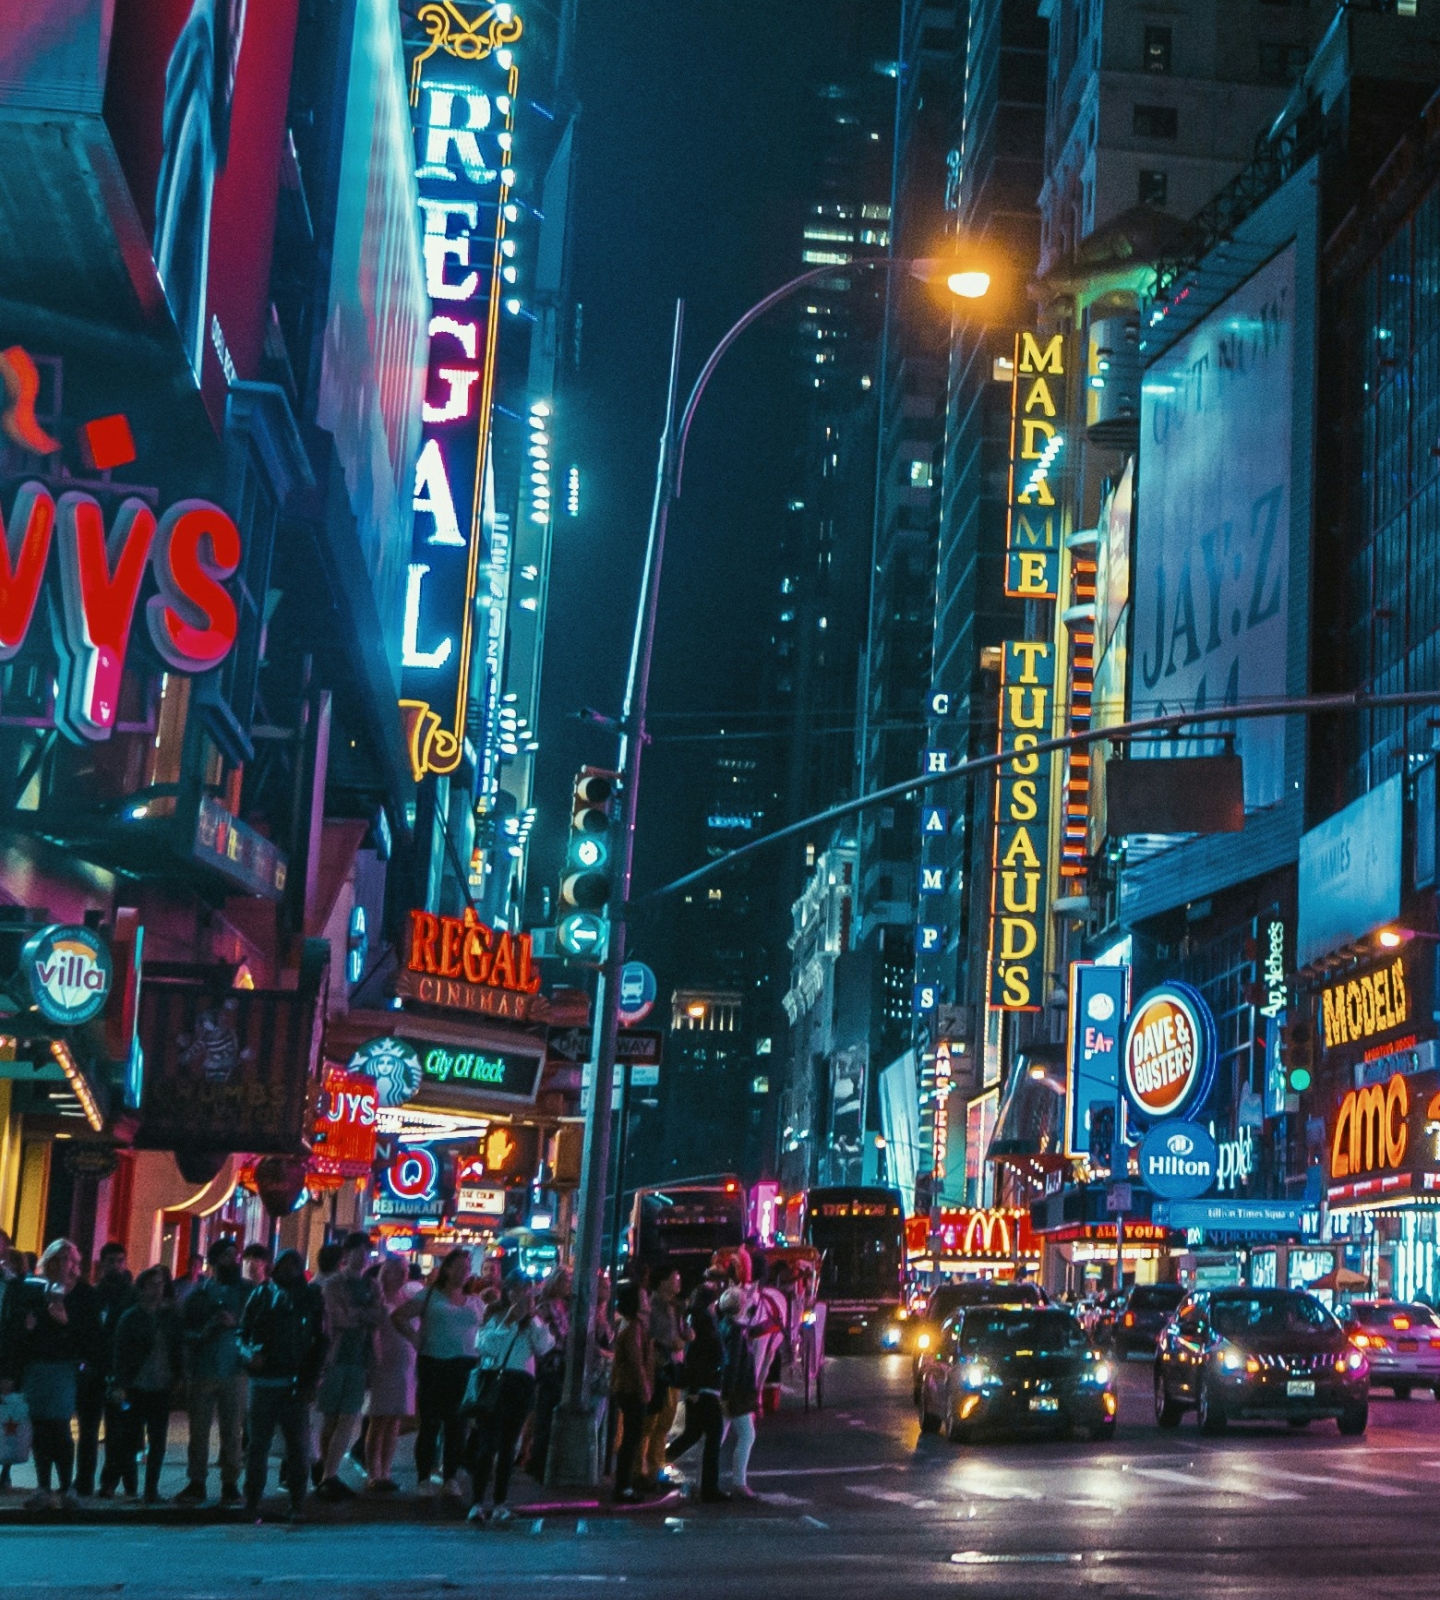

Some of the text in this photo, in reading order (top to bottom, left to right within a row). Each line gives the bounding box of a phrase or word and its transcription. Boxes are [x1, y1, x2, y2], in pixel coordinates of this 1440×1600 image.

[402, 81, 498, 669] REGAL
[1015, 334, 1064, 595] MADAME
[919, 693, 949, 1009] CHAMPS
[38, 956, 103, 990] villa
[408, 909, 541, 995] REGAL
[419, 977, 526, 1019] CINEMAS
[1132, 1013, 1191, 1067] DAVE &
[425, 1051, 506, 1083] City Of Rock
[1134, 1042, 1192, 1094] BUSTER'S
[1149, 1156, 1211, 1176] Hilton
[372, 1200, 446, 1216] RESTAURANT
